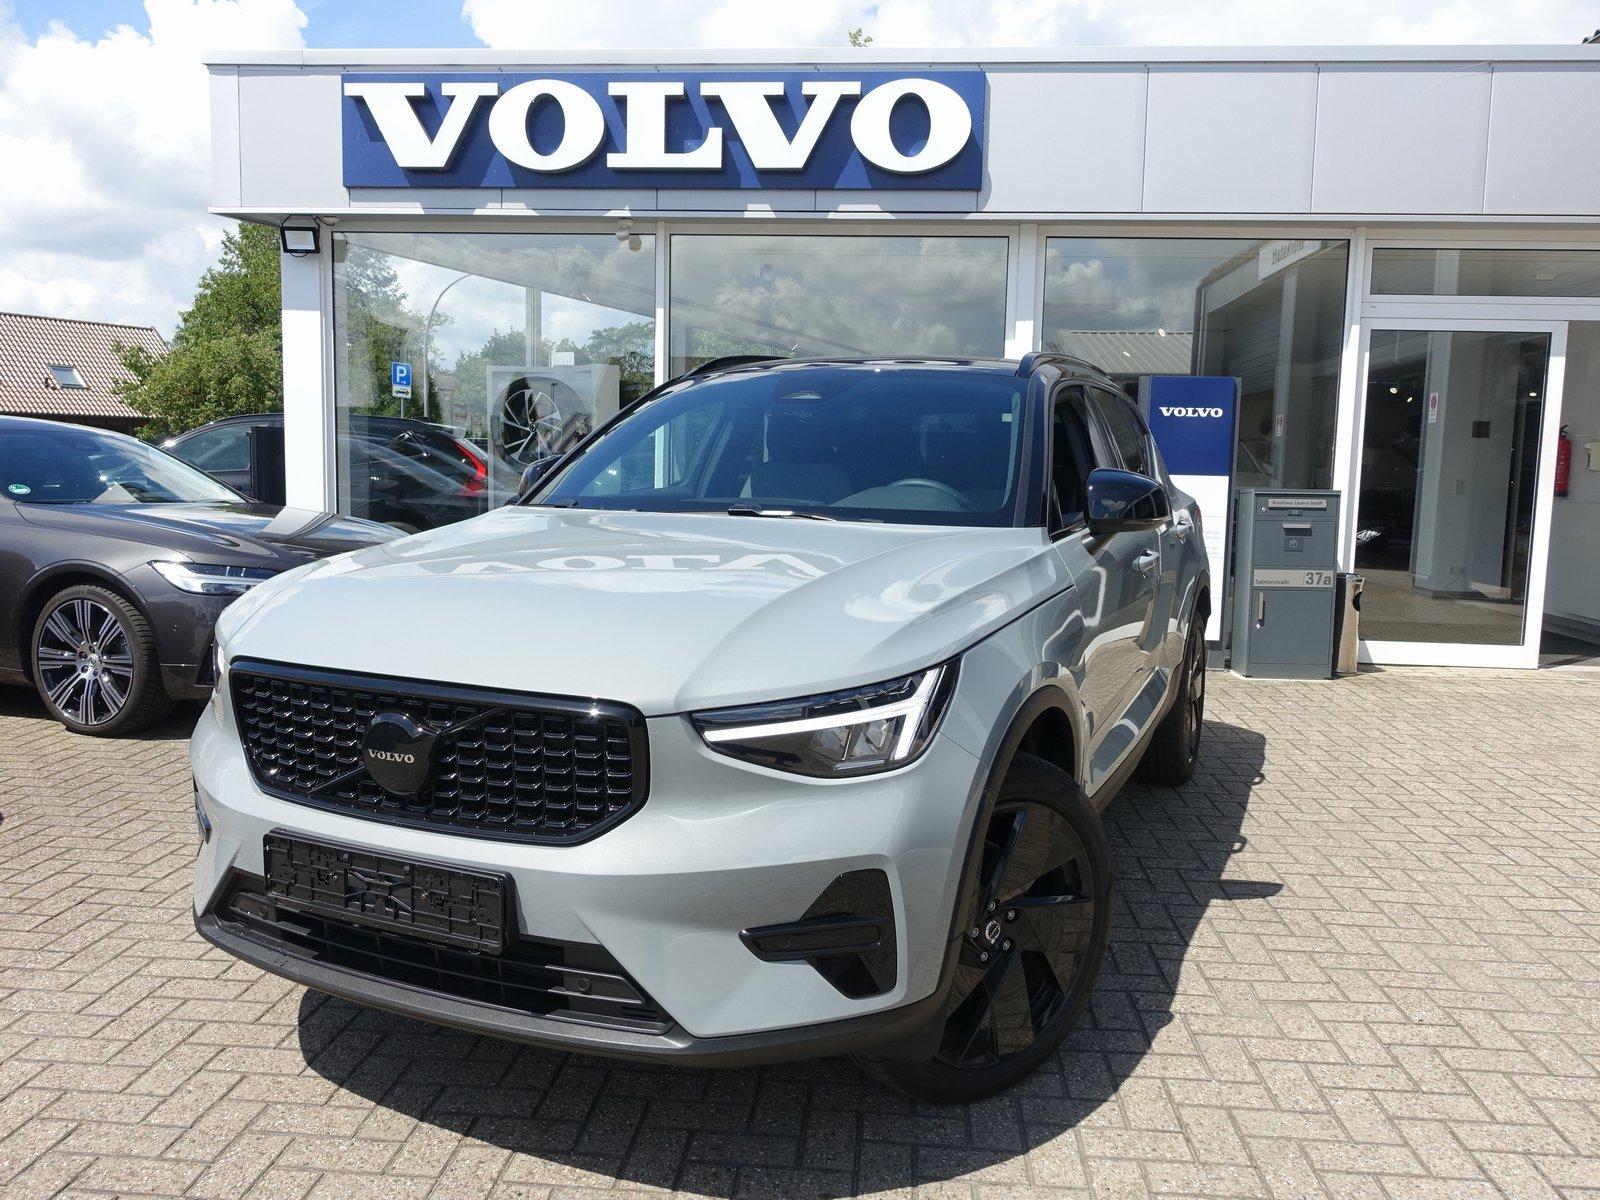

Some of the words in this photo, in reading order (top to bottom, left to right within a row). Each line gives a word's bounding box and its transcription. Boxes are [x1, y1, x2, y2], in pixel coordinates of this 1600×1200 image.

[344, 78, 972, 173] VOLVO
[397, 366, 407, 383] P
[1159, 406, 1223, 418] VOLVO
[1305, 572, 1332, 586] 37a
[368, 748, 415, 764] VOLVO
